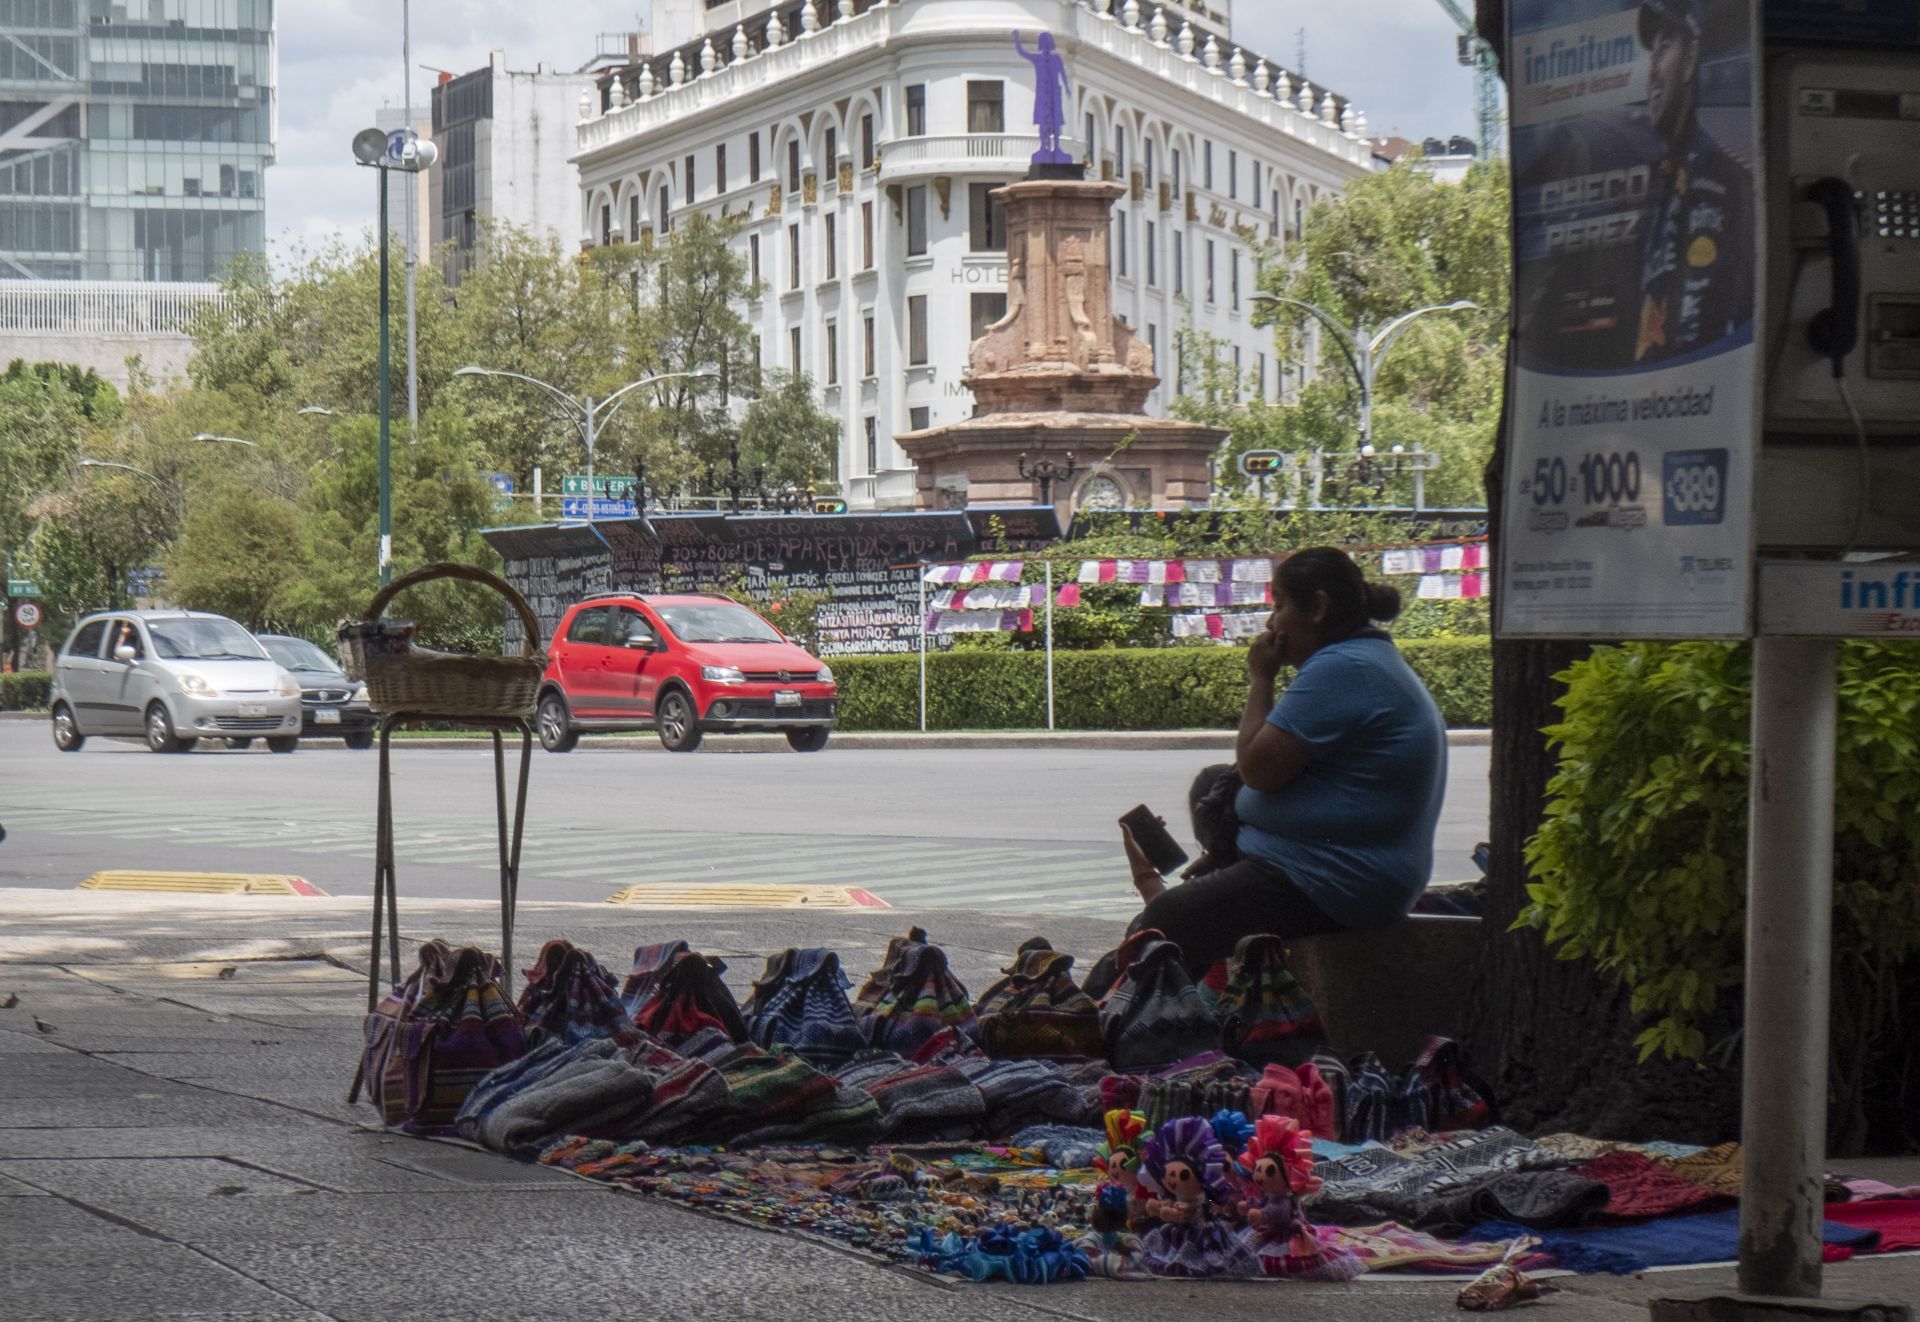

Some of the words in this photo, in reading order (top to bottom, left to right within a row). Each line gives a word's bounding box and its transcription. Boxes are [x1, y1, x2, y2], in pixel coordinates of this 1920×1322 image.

[1525, 34, 1632, 85] infinitum
[951, 268, 1008, 283] HOTE
[1537, 399, 1550, 428] A
[1552, 399, 1566, 427] la
[1631, 385, 1715, 420] velocidad
[1533, 456, 1567, 505] 50
[1579, 450, 1640, 505] 1000
[581, 479, 637, 493] BLERA
[898, 580, 937, 593] GARIA
[851, 625, 892, 640] MUÑOZ
